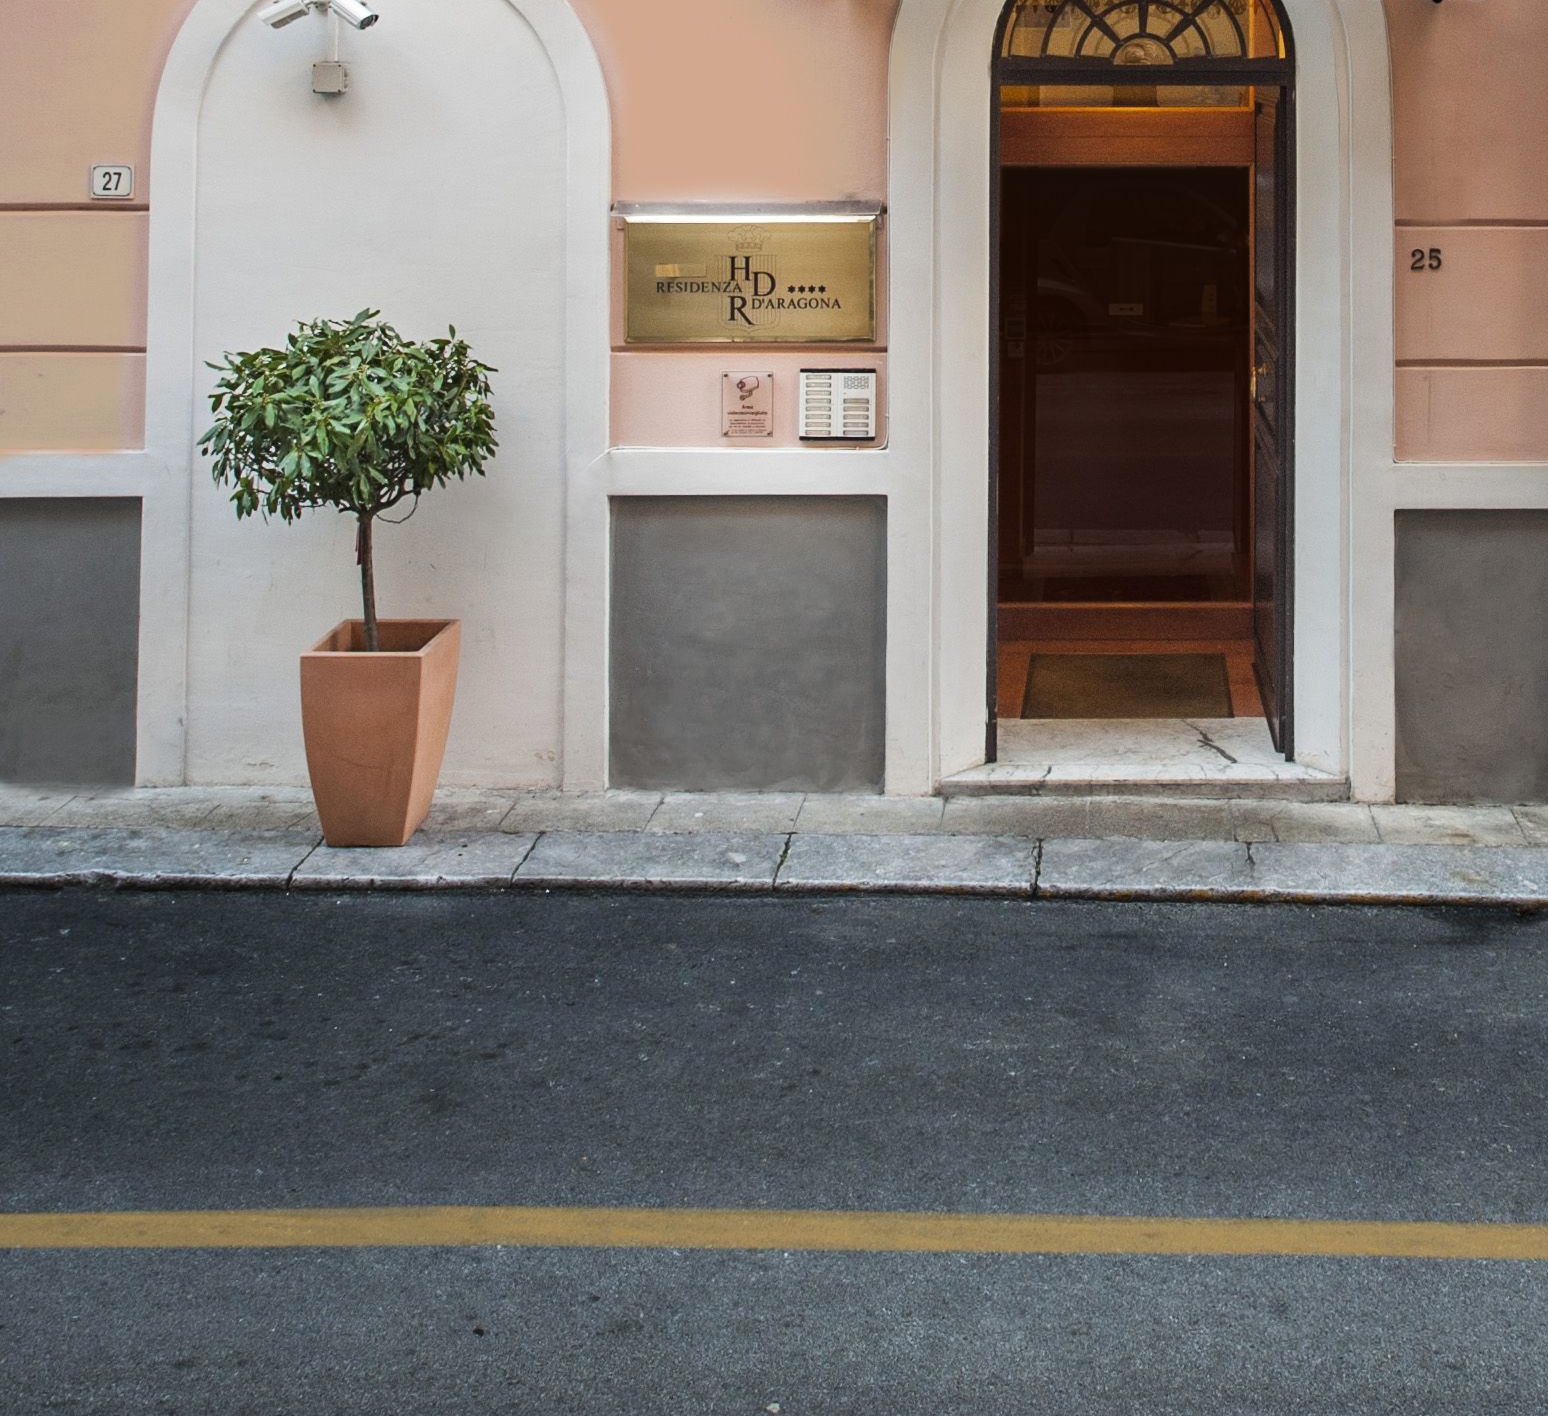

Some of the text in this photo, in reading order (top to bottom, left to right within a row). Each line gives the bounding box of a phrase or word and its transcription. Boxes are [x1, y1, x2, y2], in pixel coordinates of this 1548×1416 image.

[102, 171, 122, 191] 27
[1410, 247, 1442, 271] 25
[656, 281, 743, 293] RESIDENZA
[751, 297, 841, 310] D'ARAGONA
